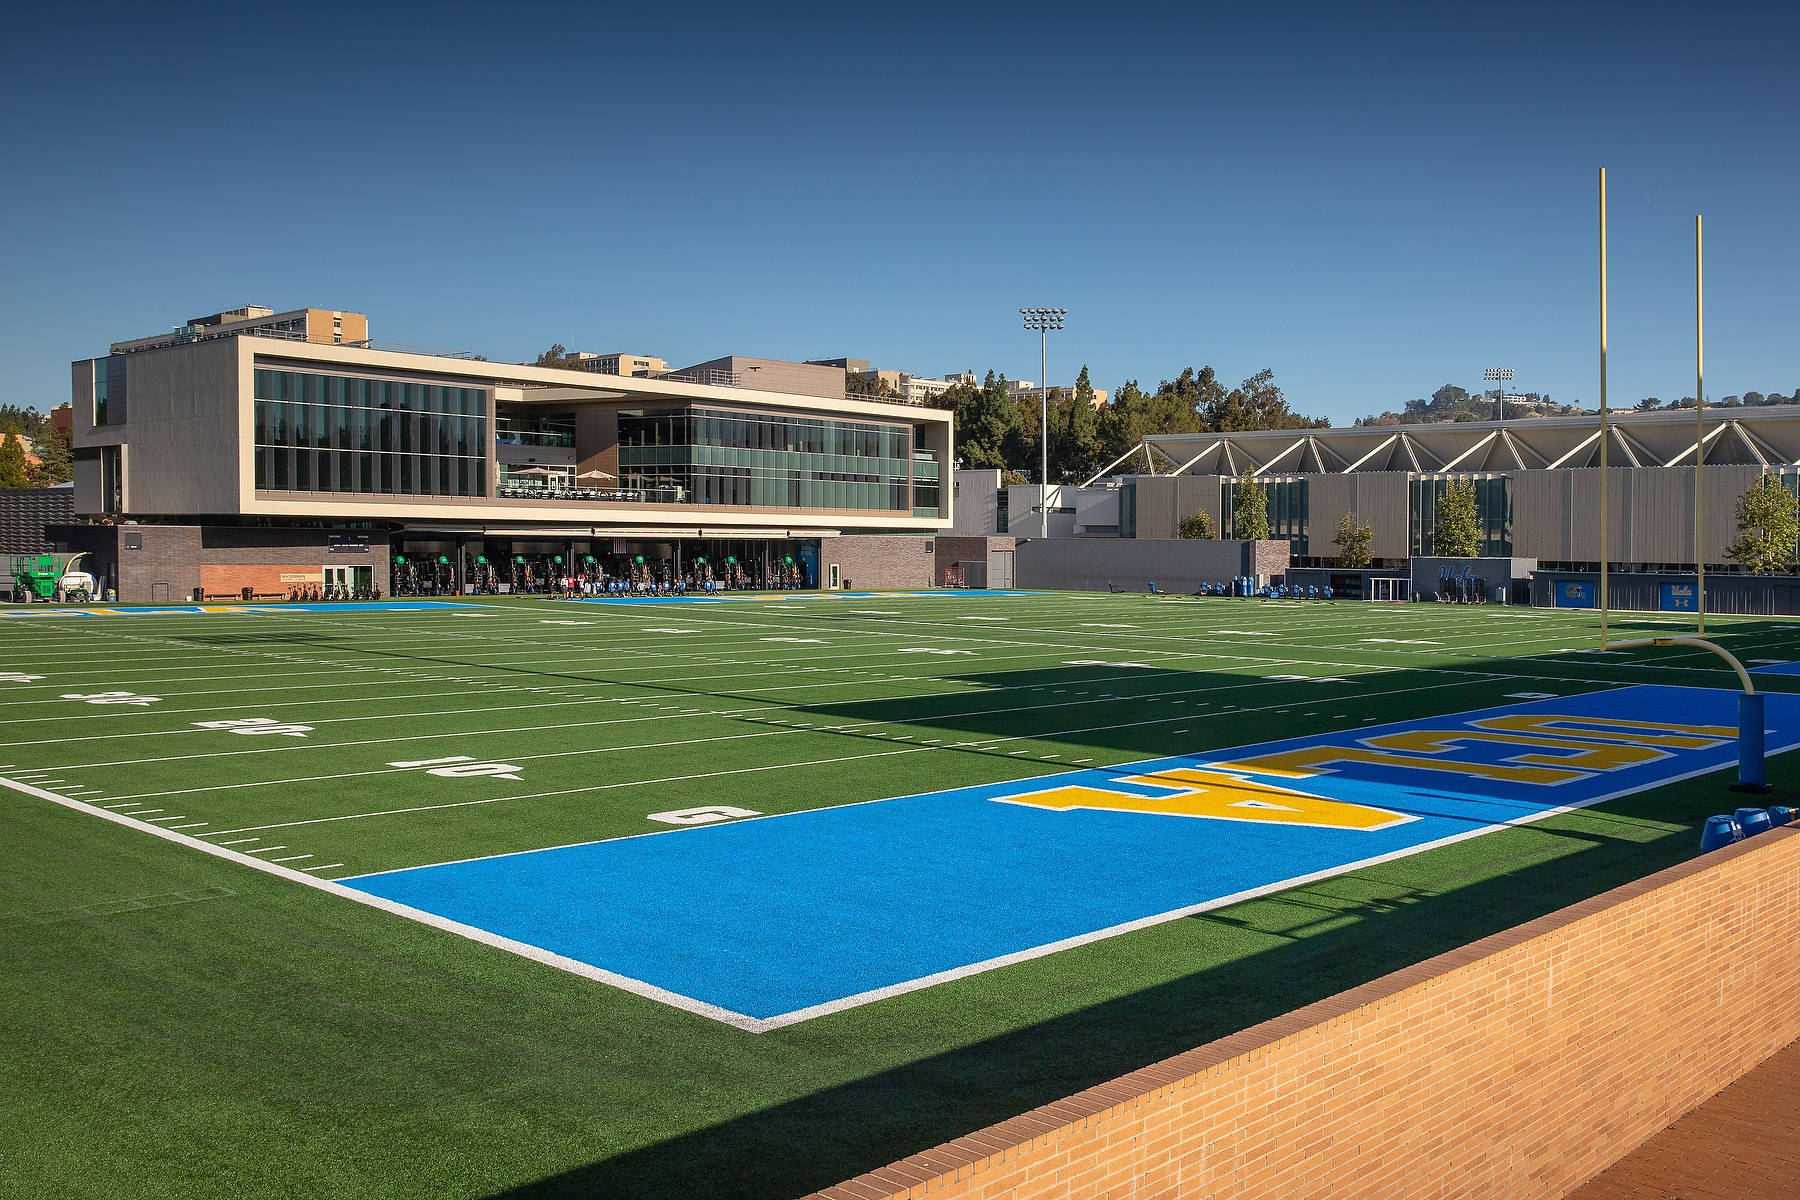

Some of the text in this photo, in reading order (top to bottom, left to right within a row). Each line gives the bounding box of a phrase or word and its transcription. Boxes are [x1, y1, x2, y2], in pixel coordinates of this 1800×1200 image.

[190, 717, 316, 735] 20
[385, 755, 524, 777] 10
[988, 714, 1777, 832] UCLA
[647, 805, 764, 825] G
